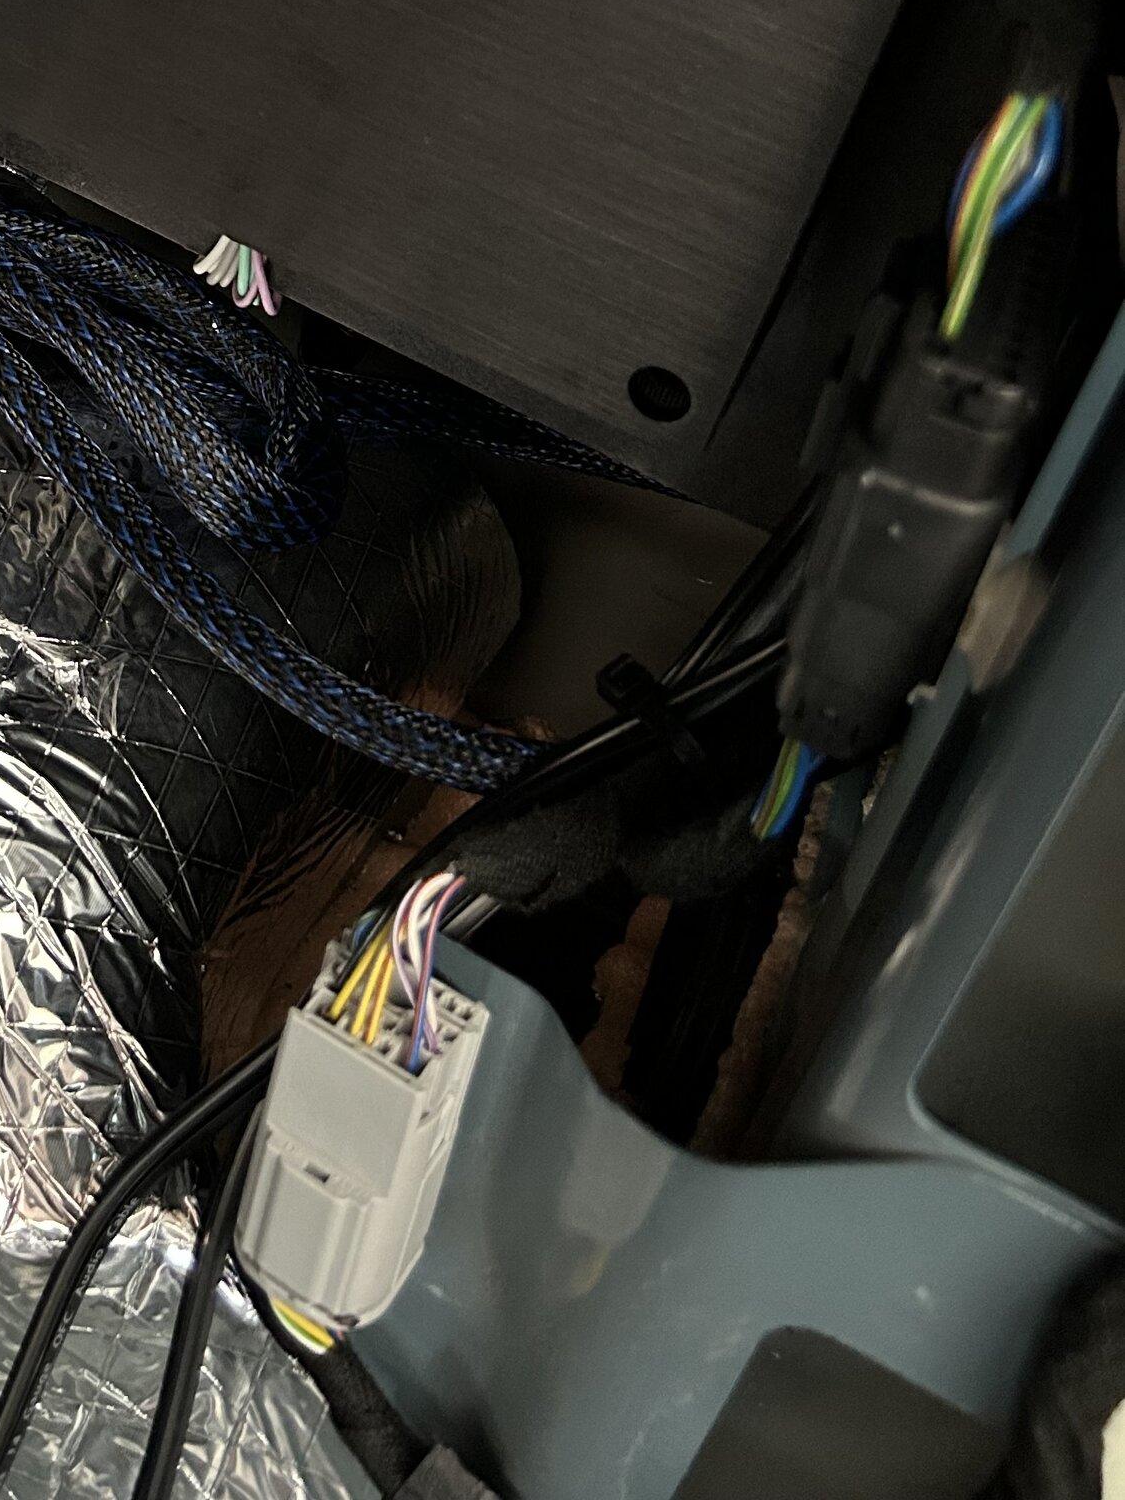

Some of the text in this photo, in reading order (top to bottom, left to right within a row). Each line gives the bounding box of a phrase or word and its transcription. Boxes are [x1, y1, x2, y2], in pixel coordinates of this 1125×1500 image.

[52, 1196, 140, 1350] OFC Audio Cable
